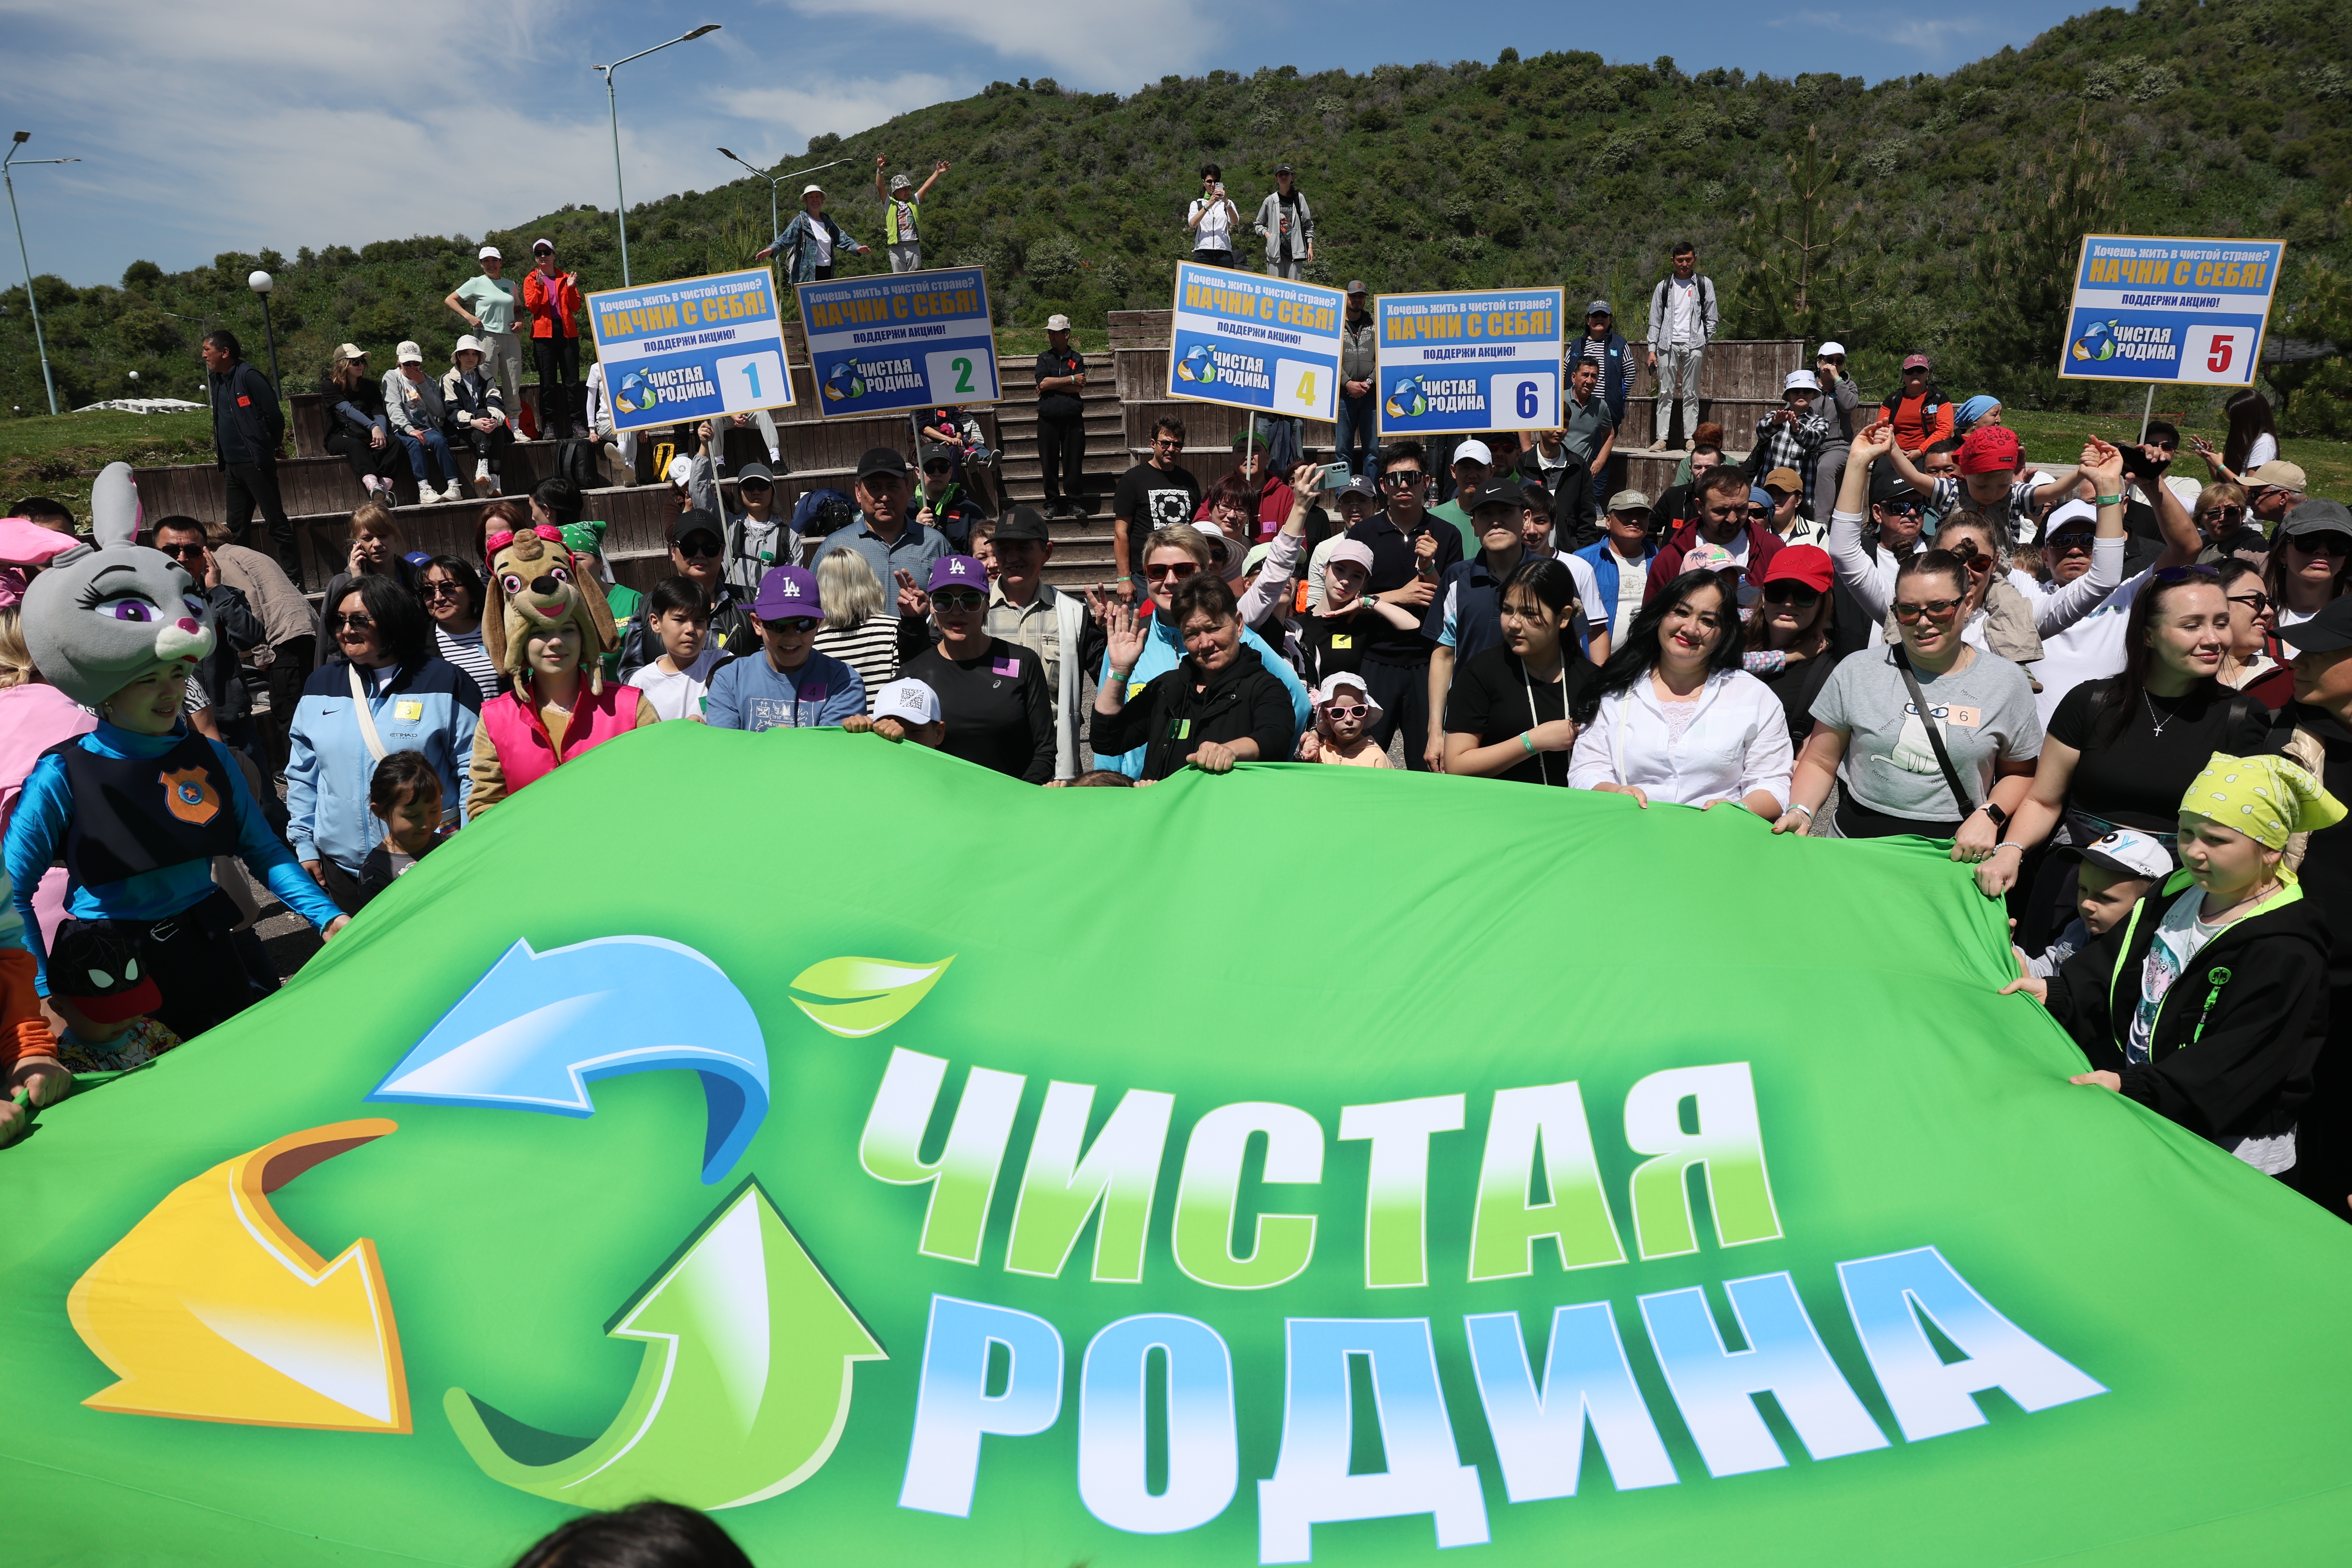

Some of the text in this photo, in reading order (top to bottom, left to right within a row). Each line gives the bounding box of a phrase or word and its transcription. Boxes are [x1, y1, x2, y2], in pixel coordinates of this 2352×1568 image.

[2093, 245, 2270, 262] Хочешь жить в чистой стране?
[2089, 258, 2267, 287] НАЧНИ С СЕБЯ!
[599, 279, 762, 312] Хочешь жить в чистой стране?
[809, 277, 974, 303] Хочешь жить в чистой стране?
[1188, 272, 1336, 307] Хочешь жить в чистой стране?
[811, 290, 978, 327] НАЧНИ С СЕБЯ!
[1186, 284, 1335, 331] НАЧНИ С СЕБЯ!
[1387, 298, 1552, 315] Хочешь жить в чистой стране?
[2122, 294, 2220, 308] ПОДДЕРЖИ АКЦИЮ!
[601, 291, 766, 337] НАЧНИ С СЕБЯ!
[853, 325, 946, 343] ПОДДЕРЖИ АКЦИЮ!
[1218, 321, 1301, 345] ПОДДЕРЖИ АКЦИЮ!
[1387, 311, 1552, 340] НАЧНИ С СЕБЯ!
[2113, 325, 2172, 343] ЧИСТАЯ
[644, 329, 735, 352] ПОДДЕРЖИ АКЦИЮ!
[2116, 343, 2176, 360] РОДИНА
[1213, 351, 1263, 373] ЧИСТАЯ
[1423, 346, 1515, 360] ПОДДЕРЖИ АКЦИЮ!
[2207, 335, 2234, 372] 5
[648, 366, 703, 387] ЧИСТАЯ
[857, 359, 912, 377] ЧИСТАЯ
[951, 358, 975, 393] 2
[1217, 368, 1270, 390] РОДИНА
[742, 362, 762, 398] 1
[865, 374, 923, 392] РОДИНА
[1296, 371, 1316, 407] 4
[1422, 379, 1476, 395] ЧИСТАЯ
[657, 381, 715, 403] РОДИНА
[1516, 381, 1538, 419] 6
[1428, 396, 1485, 413] РОДИНА
[949, 557, 965, 575] LA
[783, 577, 800, 597] LA
[1002, 662, 1009, 671] 4
[808, 687, 817, 697] 4
[405, 706, 412, 715] 3
[1959, 711, 1969, 722] 6
[858, 1044, 1784, 1290] ЧИСТАЯ
[896, 1244, 2111, 1566] РОДИНА
